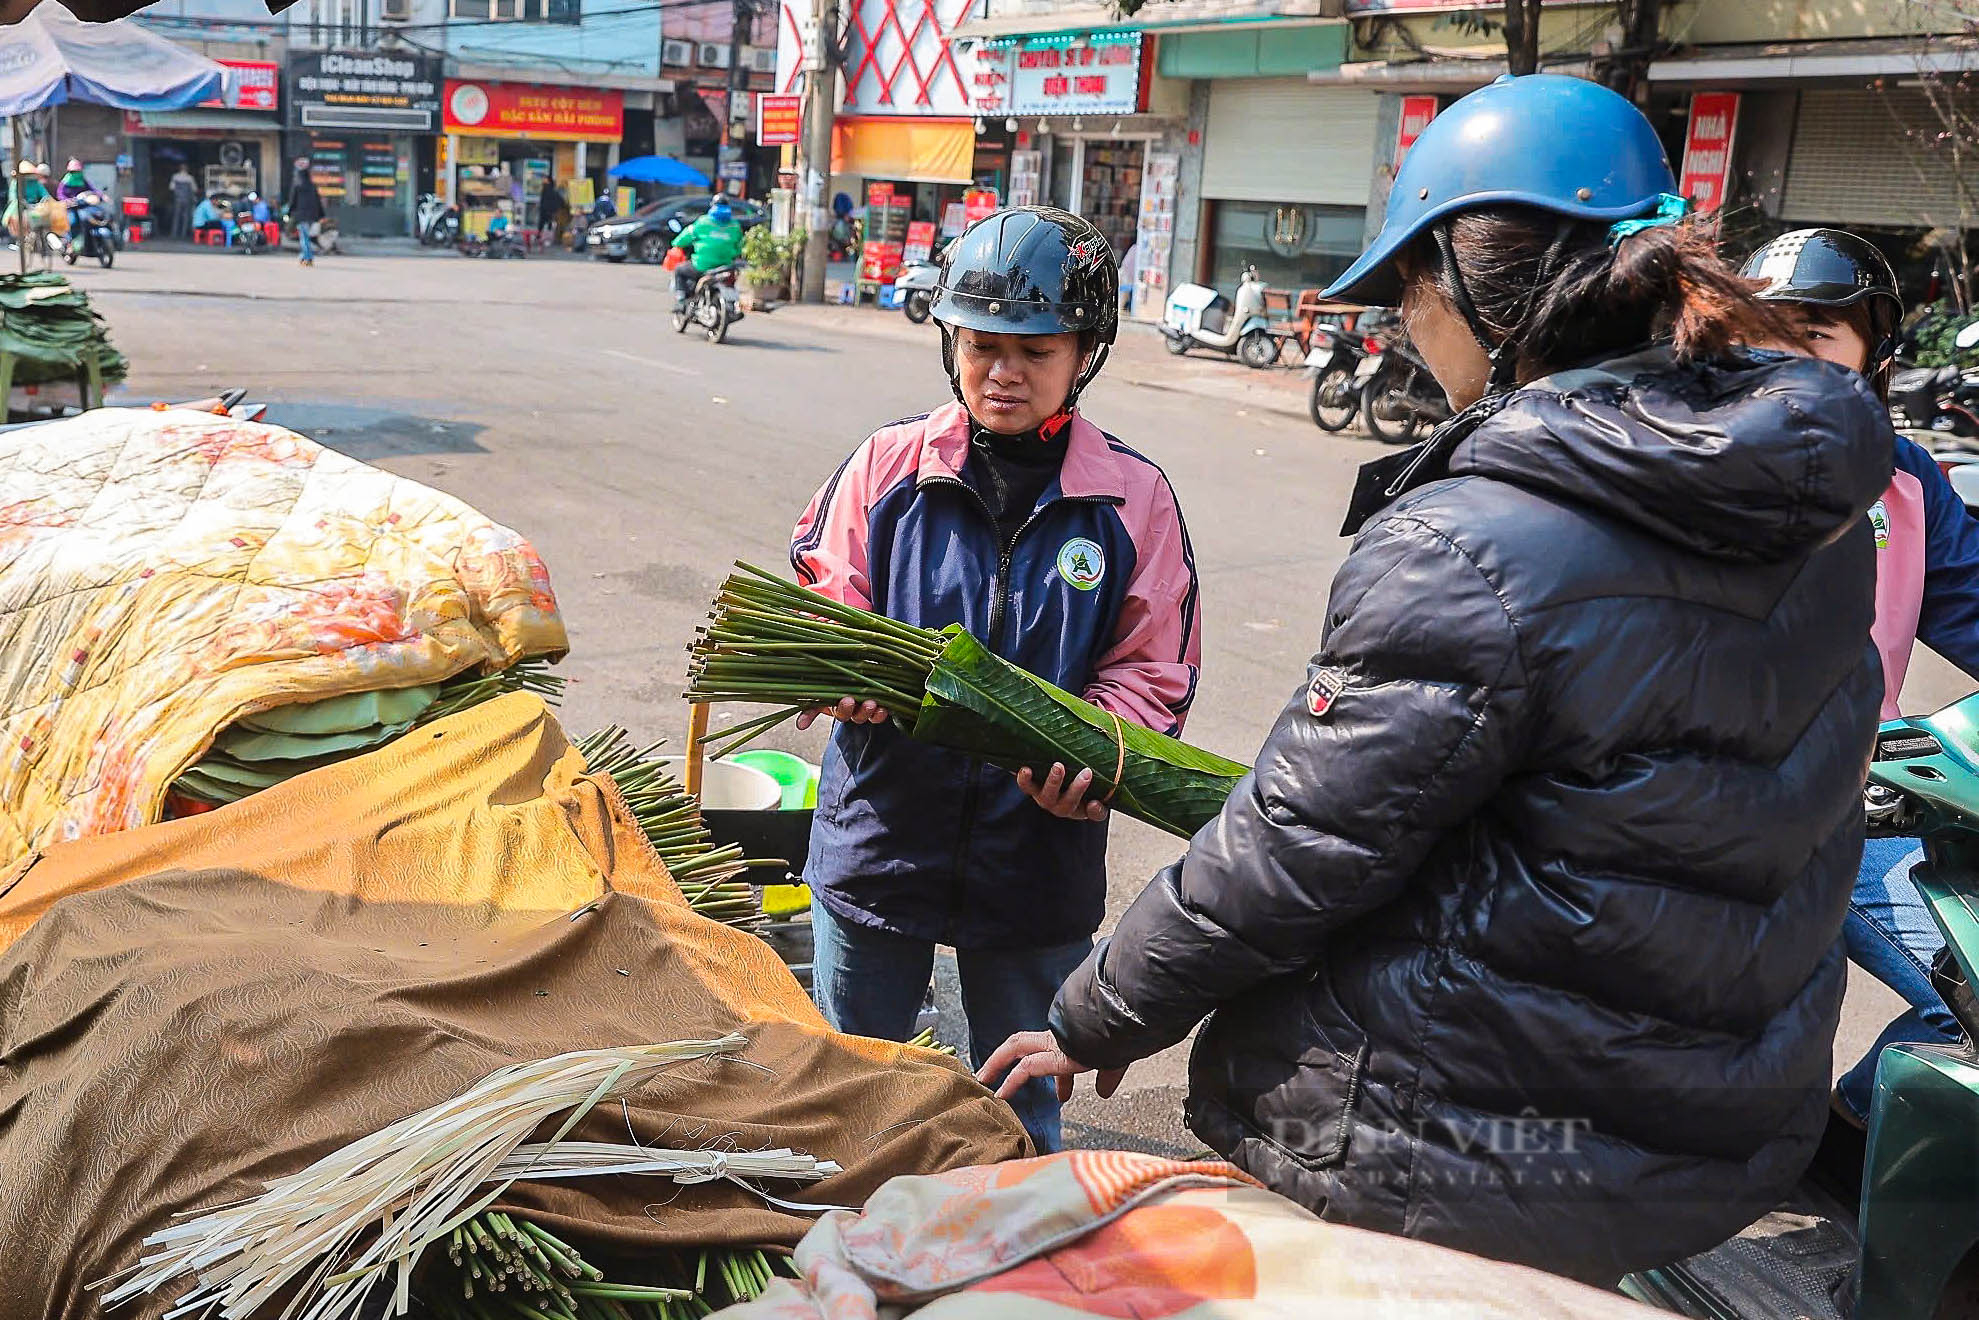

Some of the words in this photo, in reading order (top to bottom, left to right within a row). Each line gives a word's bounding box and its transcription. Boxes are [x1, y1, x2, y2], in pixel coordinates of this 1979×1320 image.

[320, 54, 415, 78] iCleanShop
[1694, 109, 1727, 139] NHÀ
[1687, 141, 1727, 174] NGHỈ
